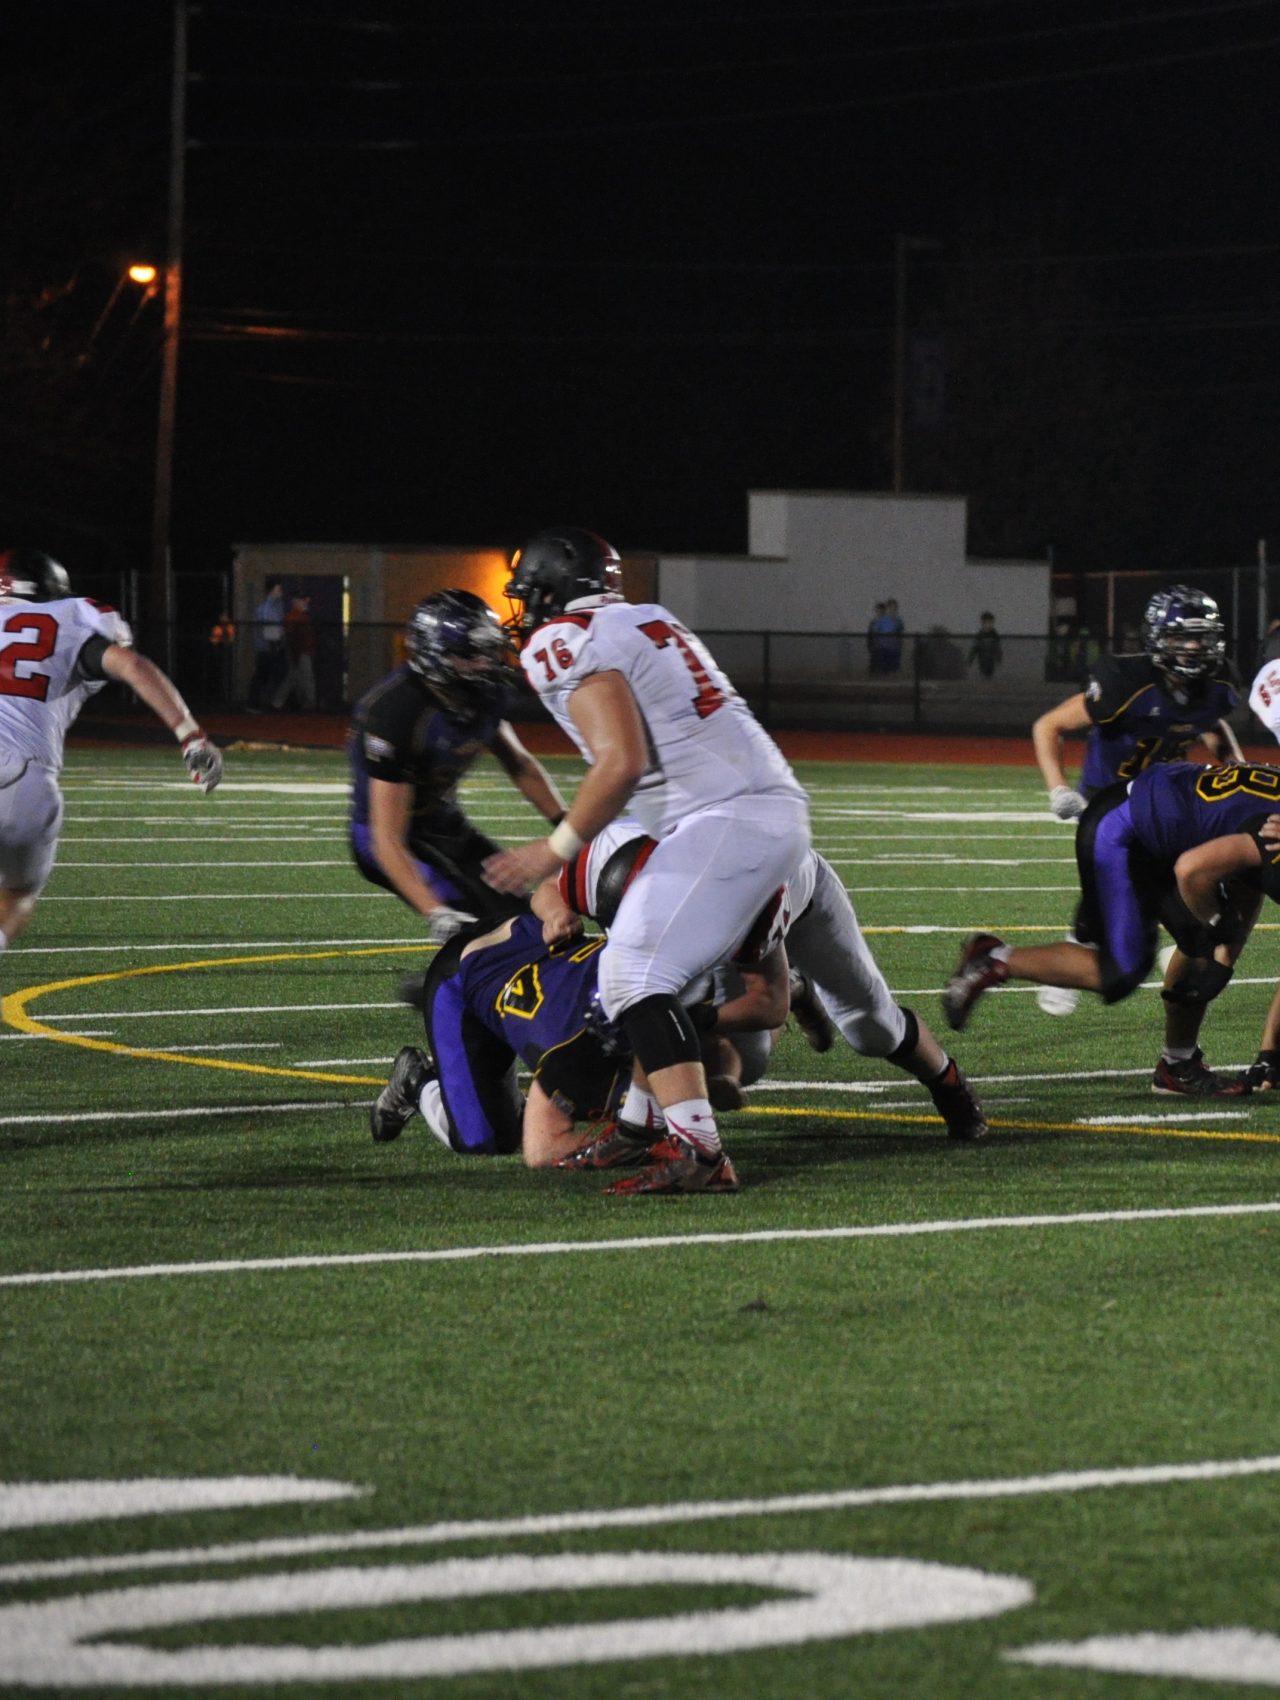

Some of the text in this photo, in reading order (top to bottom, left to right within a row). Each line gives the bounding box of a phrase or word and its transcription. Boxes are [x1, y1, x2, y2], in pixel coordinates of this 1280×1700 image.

[0, 612, 59, 702] 2
[532, 638, 575, 682] 76
[636, 619, 735, 719] 7
